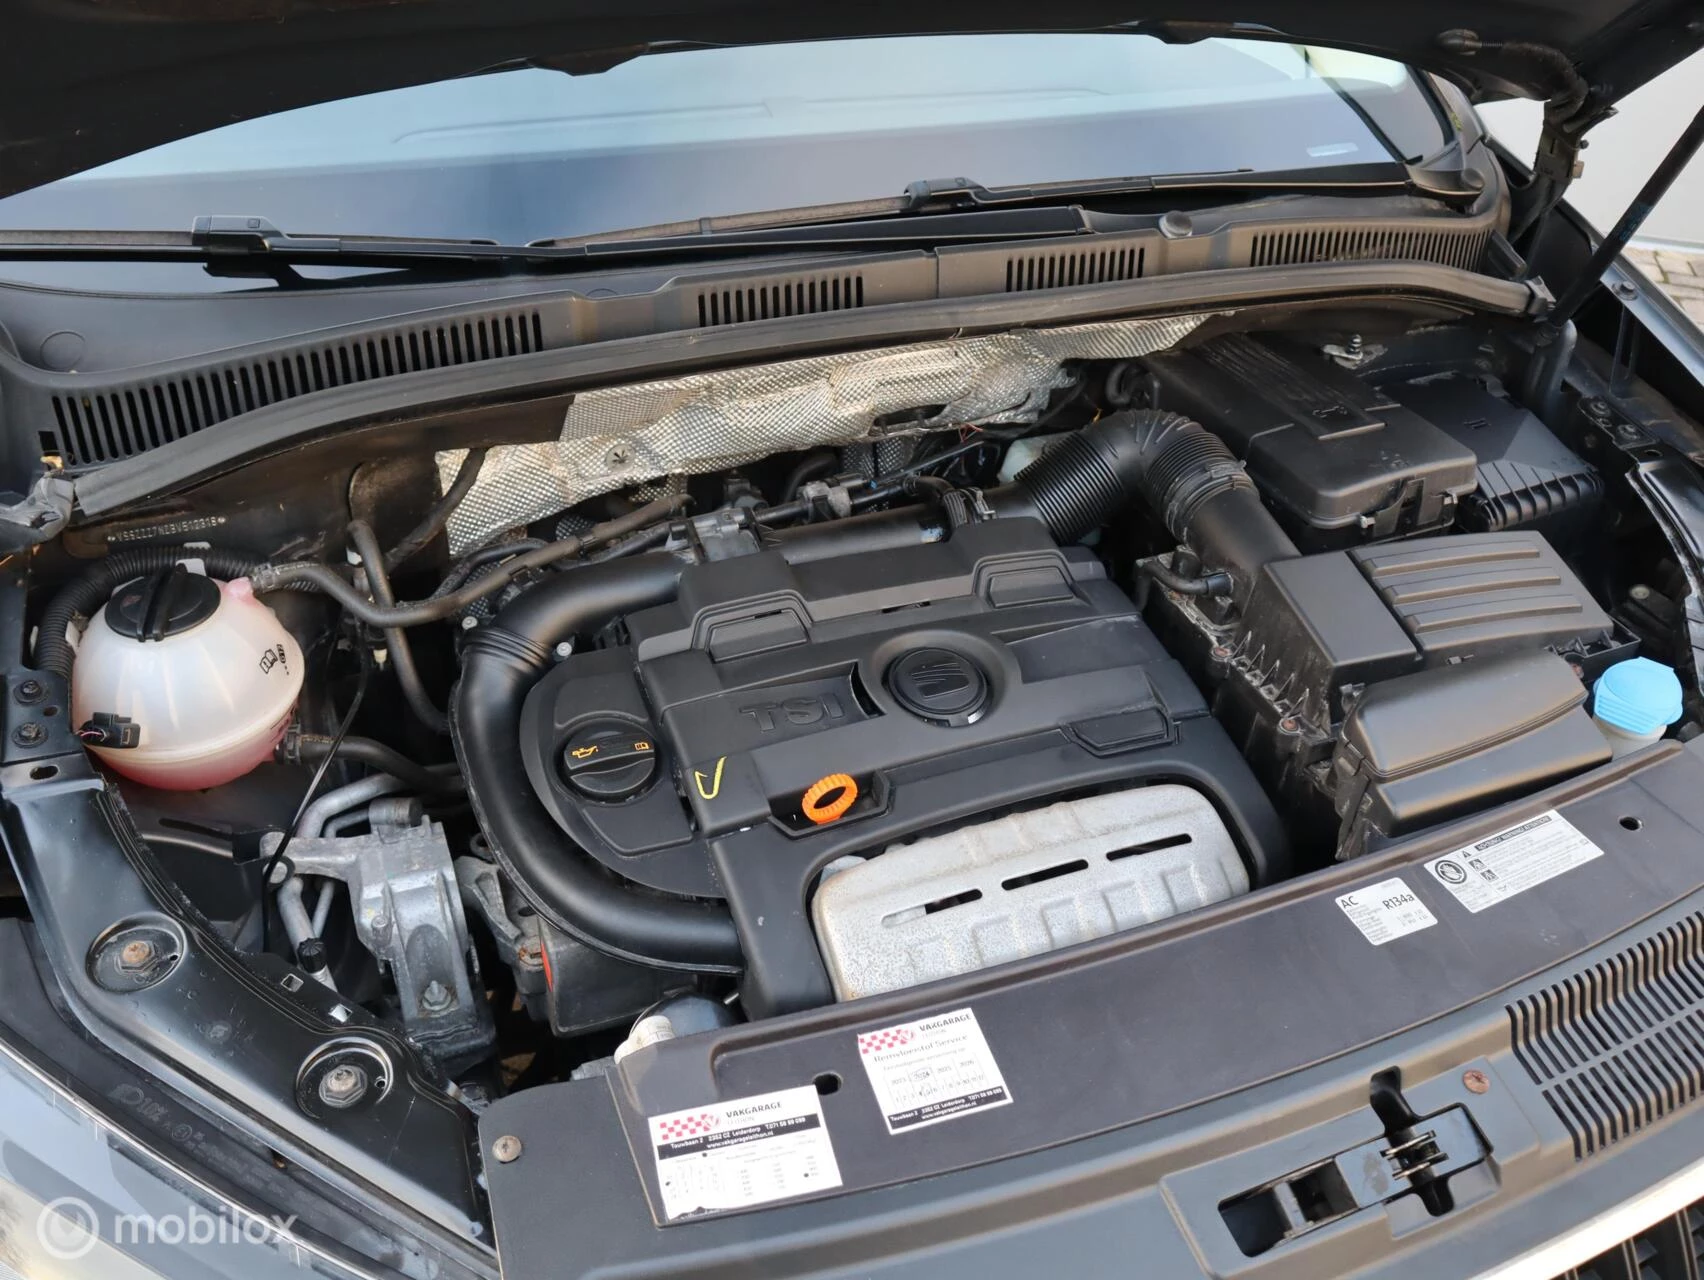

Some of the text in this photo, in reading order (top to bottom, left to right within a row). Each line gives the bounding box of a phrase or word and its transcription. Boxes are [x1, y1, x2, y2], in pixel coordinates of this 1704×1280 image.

[739, 693, 845, 733] TSI
[1340, 895, 1359, 909] AC
[1382, 894, 1415, 910] R134a
[919, 1013, 972, 1032] VAKGARAGE
[726, 1101, 782, 1118] VAKGARAGE
